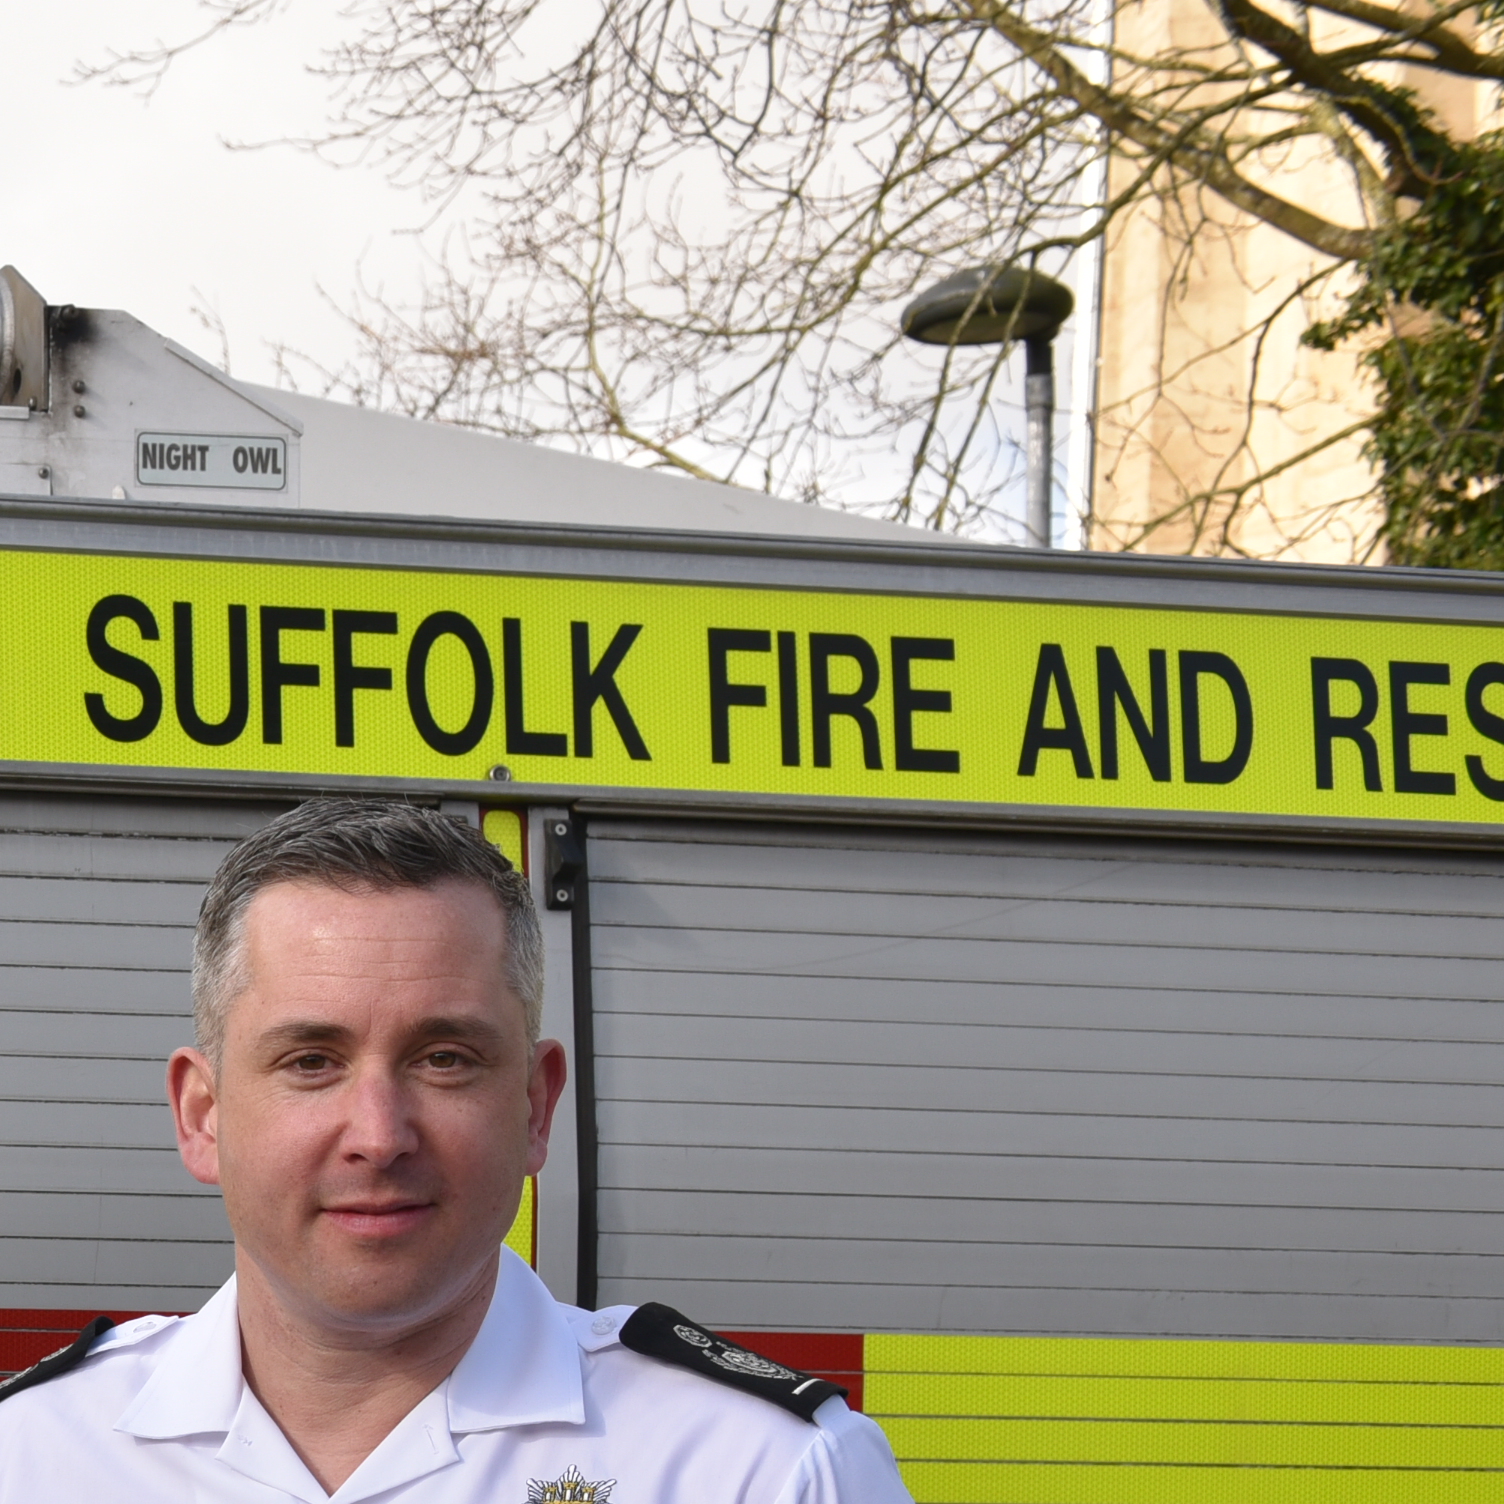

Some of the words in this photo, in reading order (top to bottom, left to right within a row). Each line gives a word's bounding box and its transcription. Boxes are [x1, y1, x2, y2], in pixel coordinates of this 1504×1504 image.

[142, 442, 209, 471] NIGHT
[232, 446, 282, 474] OWL
[84, 594, 652, 761] SUFFOLK
[707, 627, 960, 773] FIRE
[1017, 643, 1254, 785] AND
